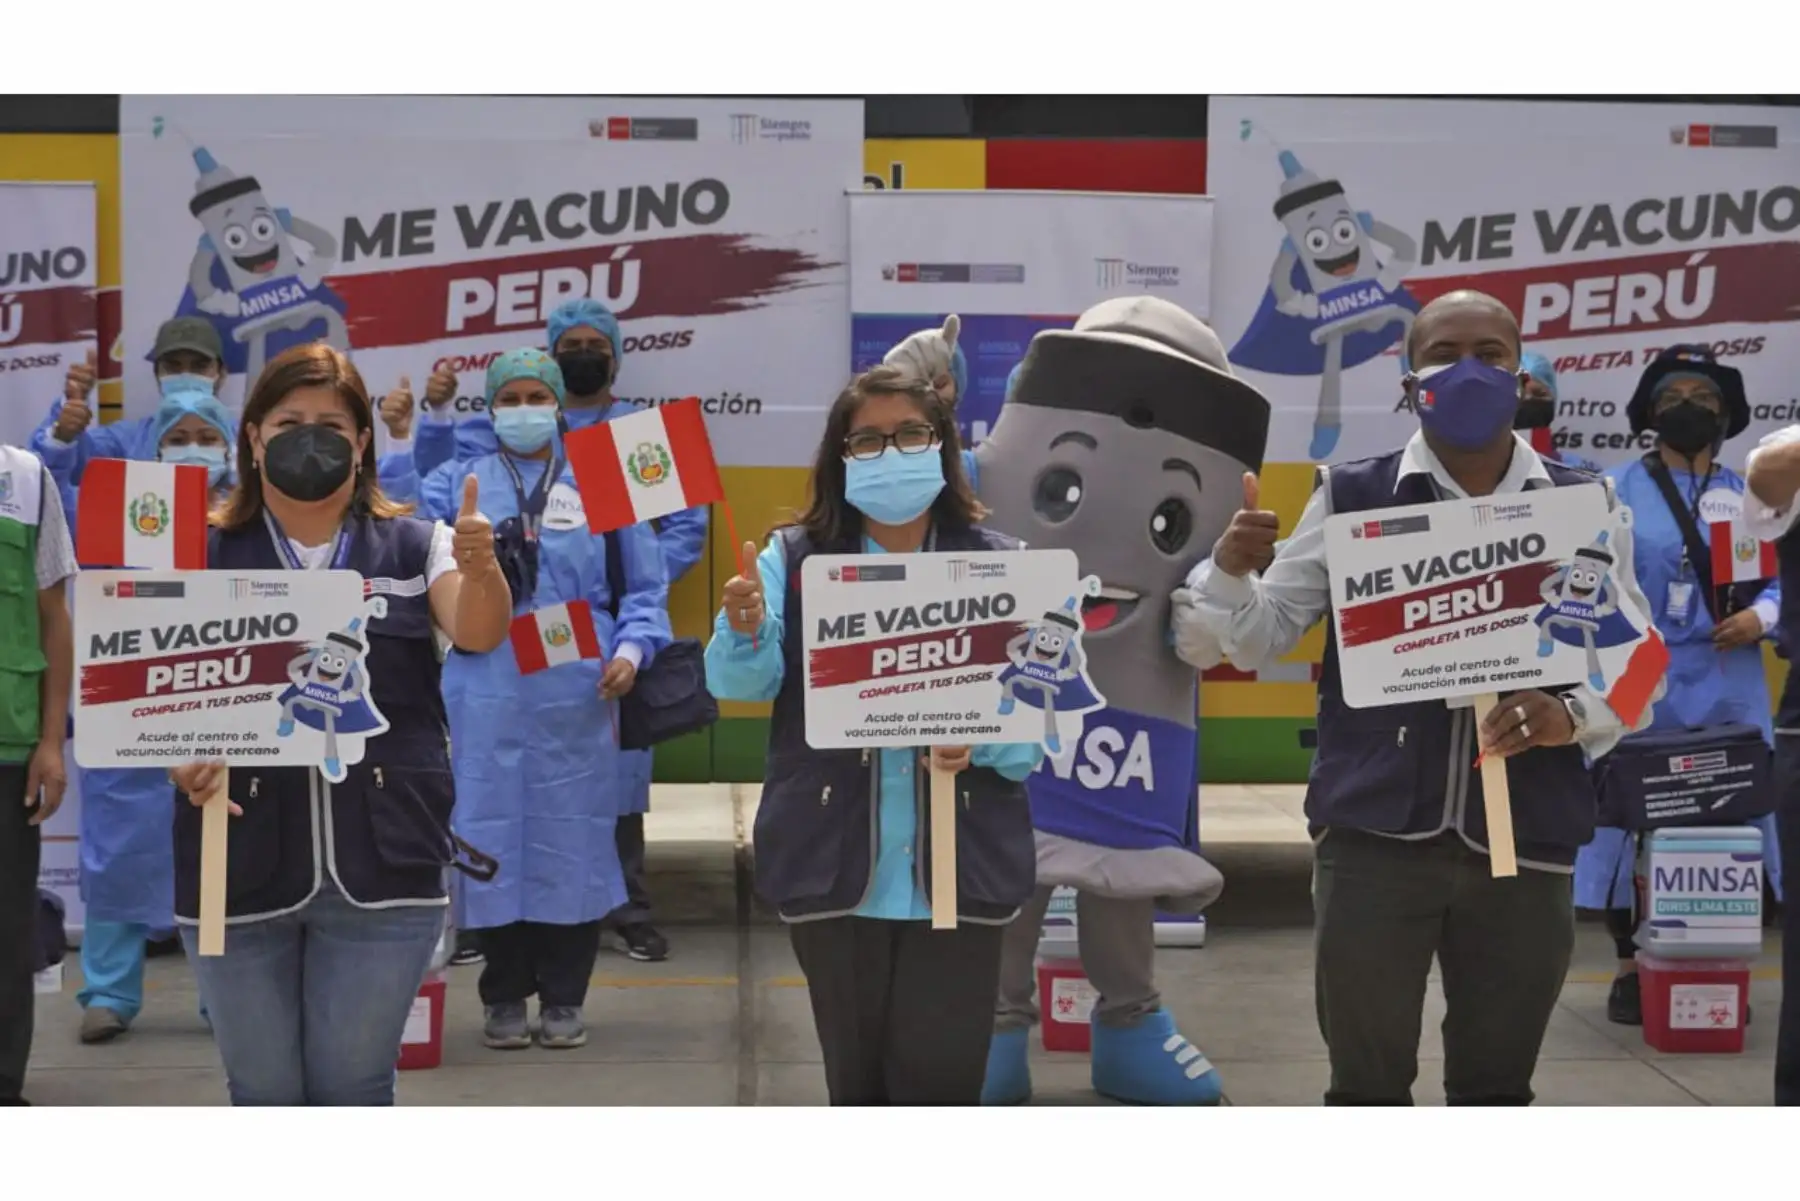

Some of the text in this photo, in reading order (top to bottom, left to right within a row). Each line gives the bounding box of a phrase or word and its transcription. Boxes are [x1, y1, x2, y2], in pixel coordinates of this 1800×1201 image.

[342, 178, 730, 262] ME VACUNO
[1420, 185, 1800, 266] ME VACUNO
[241, 284, 306, 317] MINSA
[445, 245, 641, 331] PERÚ
[1521, 252, 1717, 335] PERÚ
[1319, 286, 1384, 320] MINSA
[622, 330, 694, 353] DOSIS
[10, 353, 62, 371] DOSIS
[1557, 397, 1616, 417] ntro
[1552, 425, 1583, 449] ás
[1345, 533, 1546, 601] ME VACUNO
[1403, 573, 1503, 631] PERÚ
[817, 592, 1016, 642] ME VACUNO
[90, 612, 299, 658] ME VACUNO
[1393, 613, 1530, 654] COMPLETA TUS DOSIS
[872, 628, 972, 675] PERÚ
[146, 648, 252, 695] PERÚ
[1382, 667, 1543, 694] vacunación más cercano
[1401, 655, 1520, 678] Acude al centro de
[858, 671, 994, 699] COMPLETA TUS DOSIS
[132, 691, 273, 718] COMPLETA TUS DOSIS
[864, 711, 981, 723] Acude al centro de
[137, 731, 258, 743] Acude al centro de
[844, 723, 1002, 738] vacunación más cercano
[115, 744, 280, 757] vacunación más cercano
[1655, 866, 1759, 892] MINSA
[1694, 900, 1723, 912] LIMA
[1727, 900, 1757, 912] ESTE
